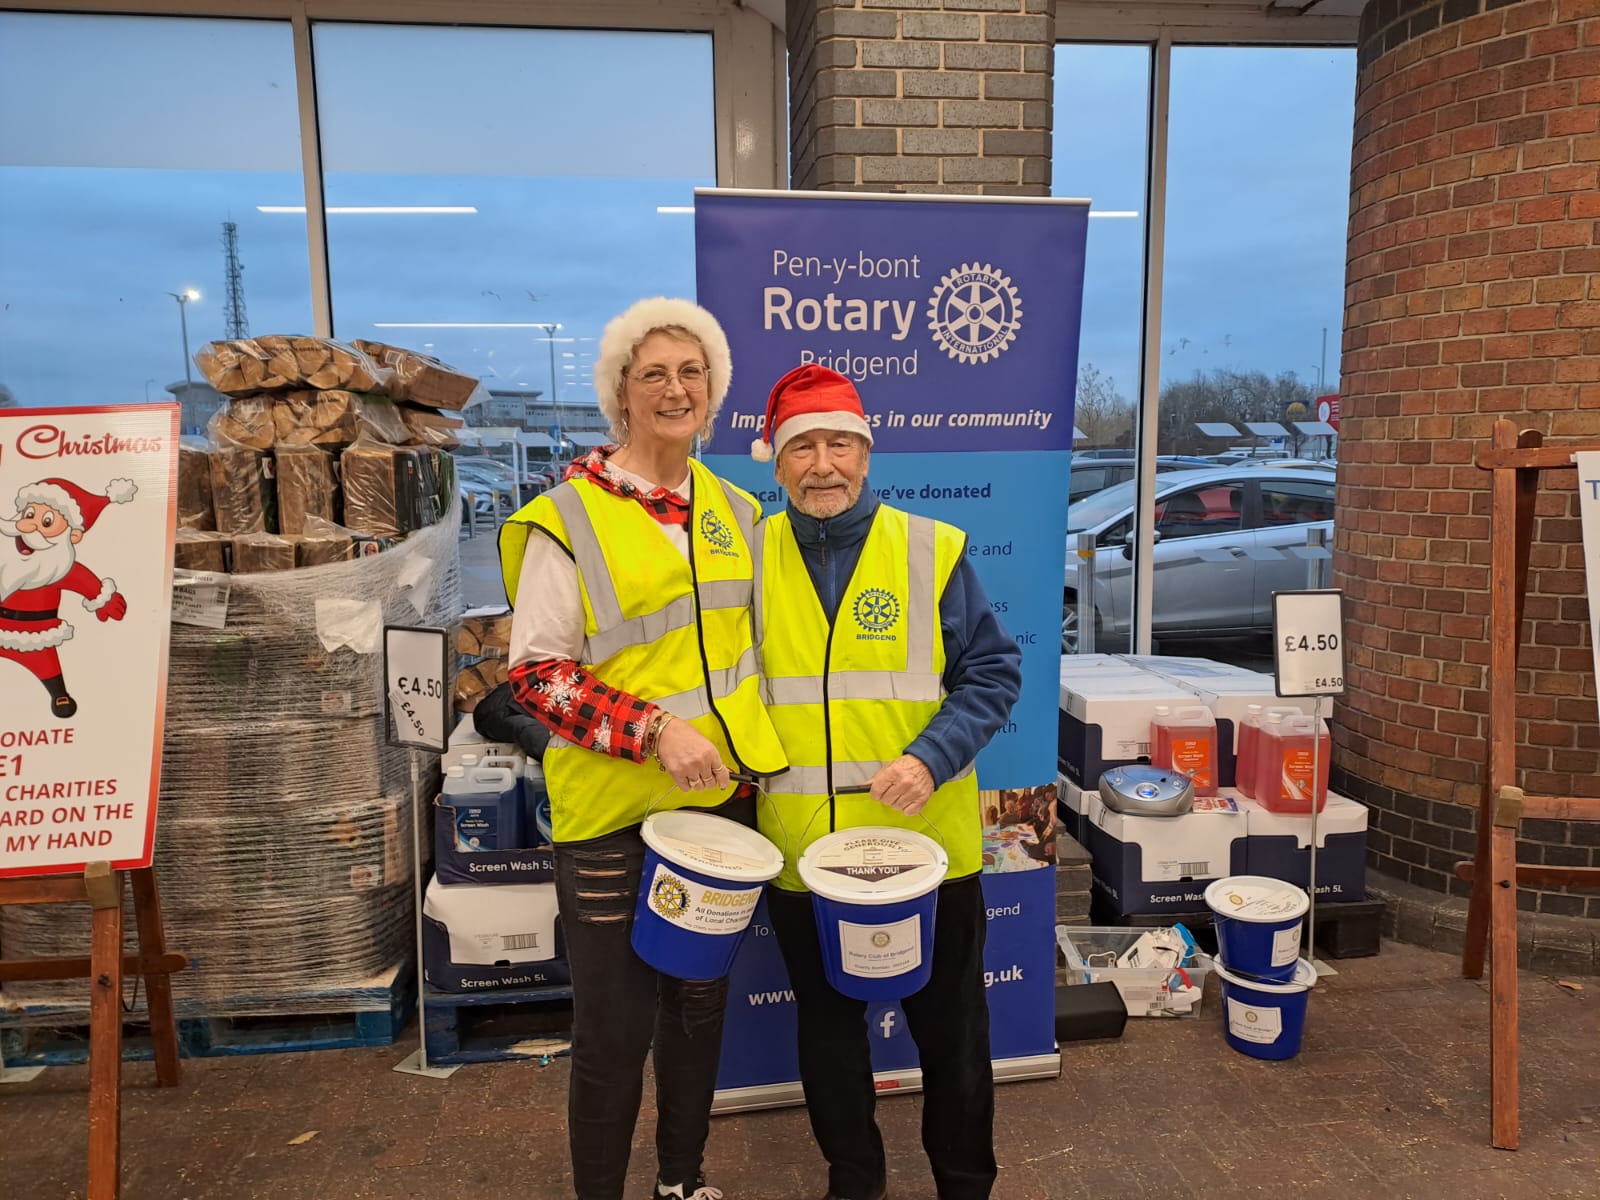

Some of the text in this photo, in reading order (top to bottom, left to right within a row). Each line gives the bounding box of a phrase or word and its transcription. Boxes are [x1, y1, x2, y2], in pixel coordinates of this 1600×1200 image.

[773, 249, 920, 283] Pen-y-bont
[956, 273, 995, 286] ROTARY
[764, 286, 916, 341] Rotary
[942, 329, 1008, 354] INTERNATIONAL
[800, 348, 918, 382] Bridgend
[731, 411, 767, 432] Imp
[887, 410, 905, 428] in
[911, 415, 944, 428] our
[948, 410, 1052, 430] community
[16, 424, 162, 460] Christmas
[920, 482, 992, 500] donated
[1584, 479, 1600, 500] T
[982, 540, 1013, 556] and
[856, 633, 897, 641] BRIDGEND
[1284, 634, 1338, 652] £4.50
[397, 676, 442, 699] £4.50
[1315, 677, 1343, 688] £4.50
[401, 701, 425, 737] £4.50
[0, 728, 75, 748] ONATE
[5, 779, 118, 801] CHARITIES
[0, 803, 134, 827] ARD ON THE
[6, 830, 113, 853] MY HAND
[844, 838, 878, 846] PLEASE
[469, 860, 555, 873] Screen Wash 5L
[846, 866, 900, 875] THANK YOU!
[1332, 884, 1344, 893] 5L
[1150, 894, 1182, 904] Screen
[695, 906, 705, 914] All
[706, 909, 740, 917] Donations
[985, 902, 1021, 920] gend
[752, 924, 769, 937] To
[460, 973, 548, 988] Screen Wash 5L
[983, 964, 1024, 988] g.uk
[748, 989, 796, 1006] www
